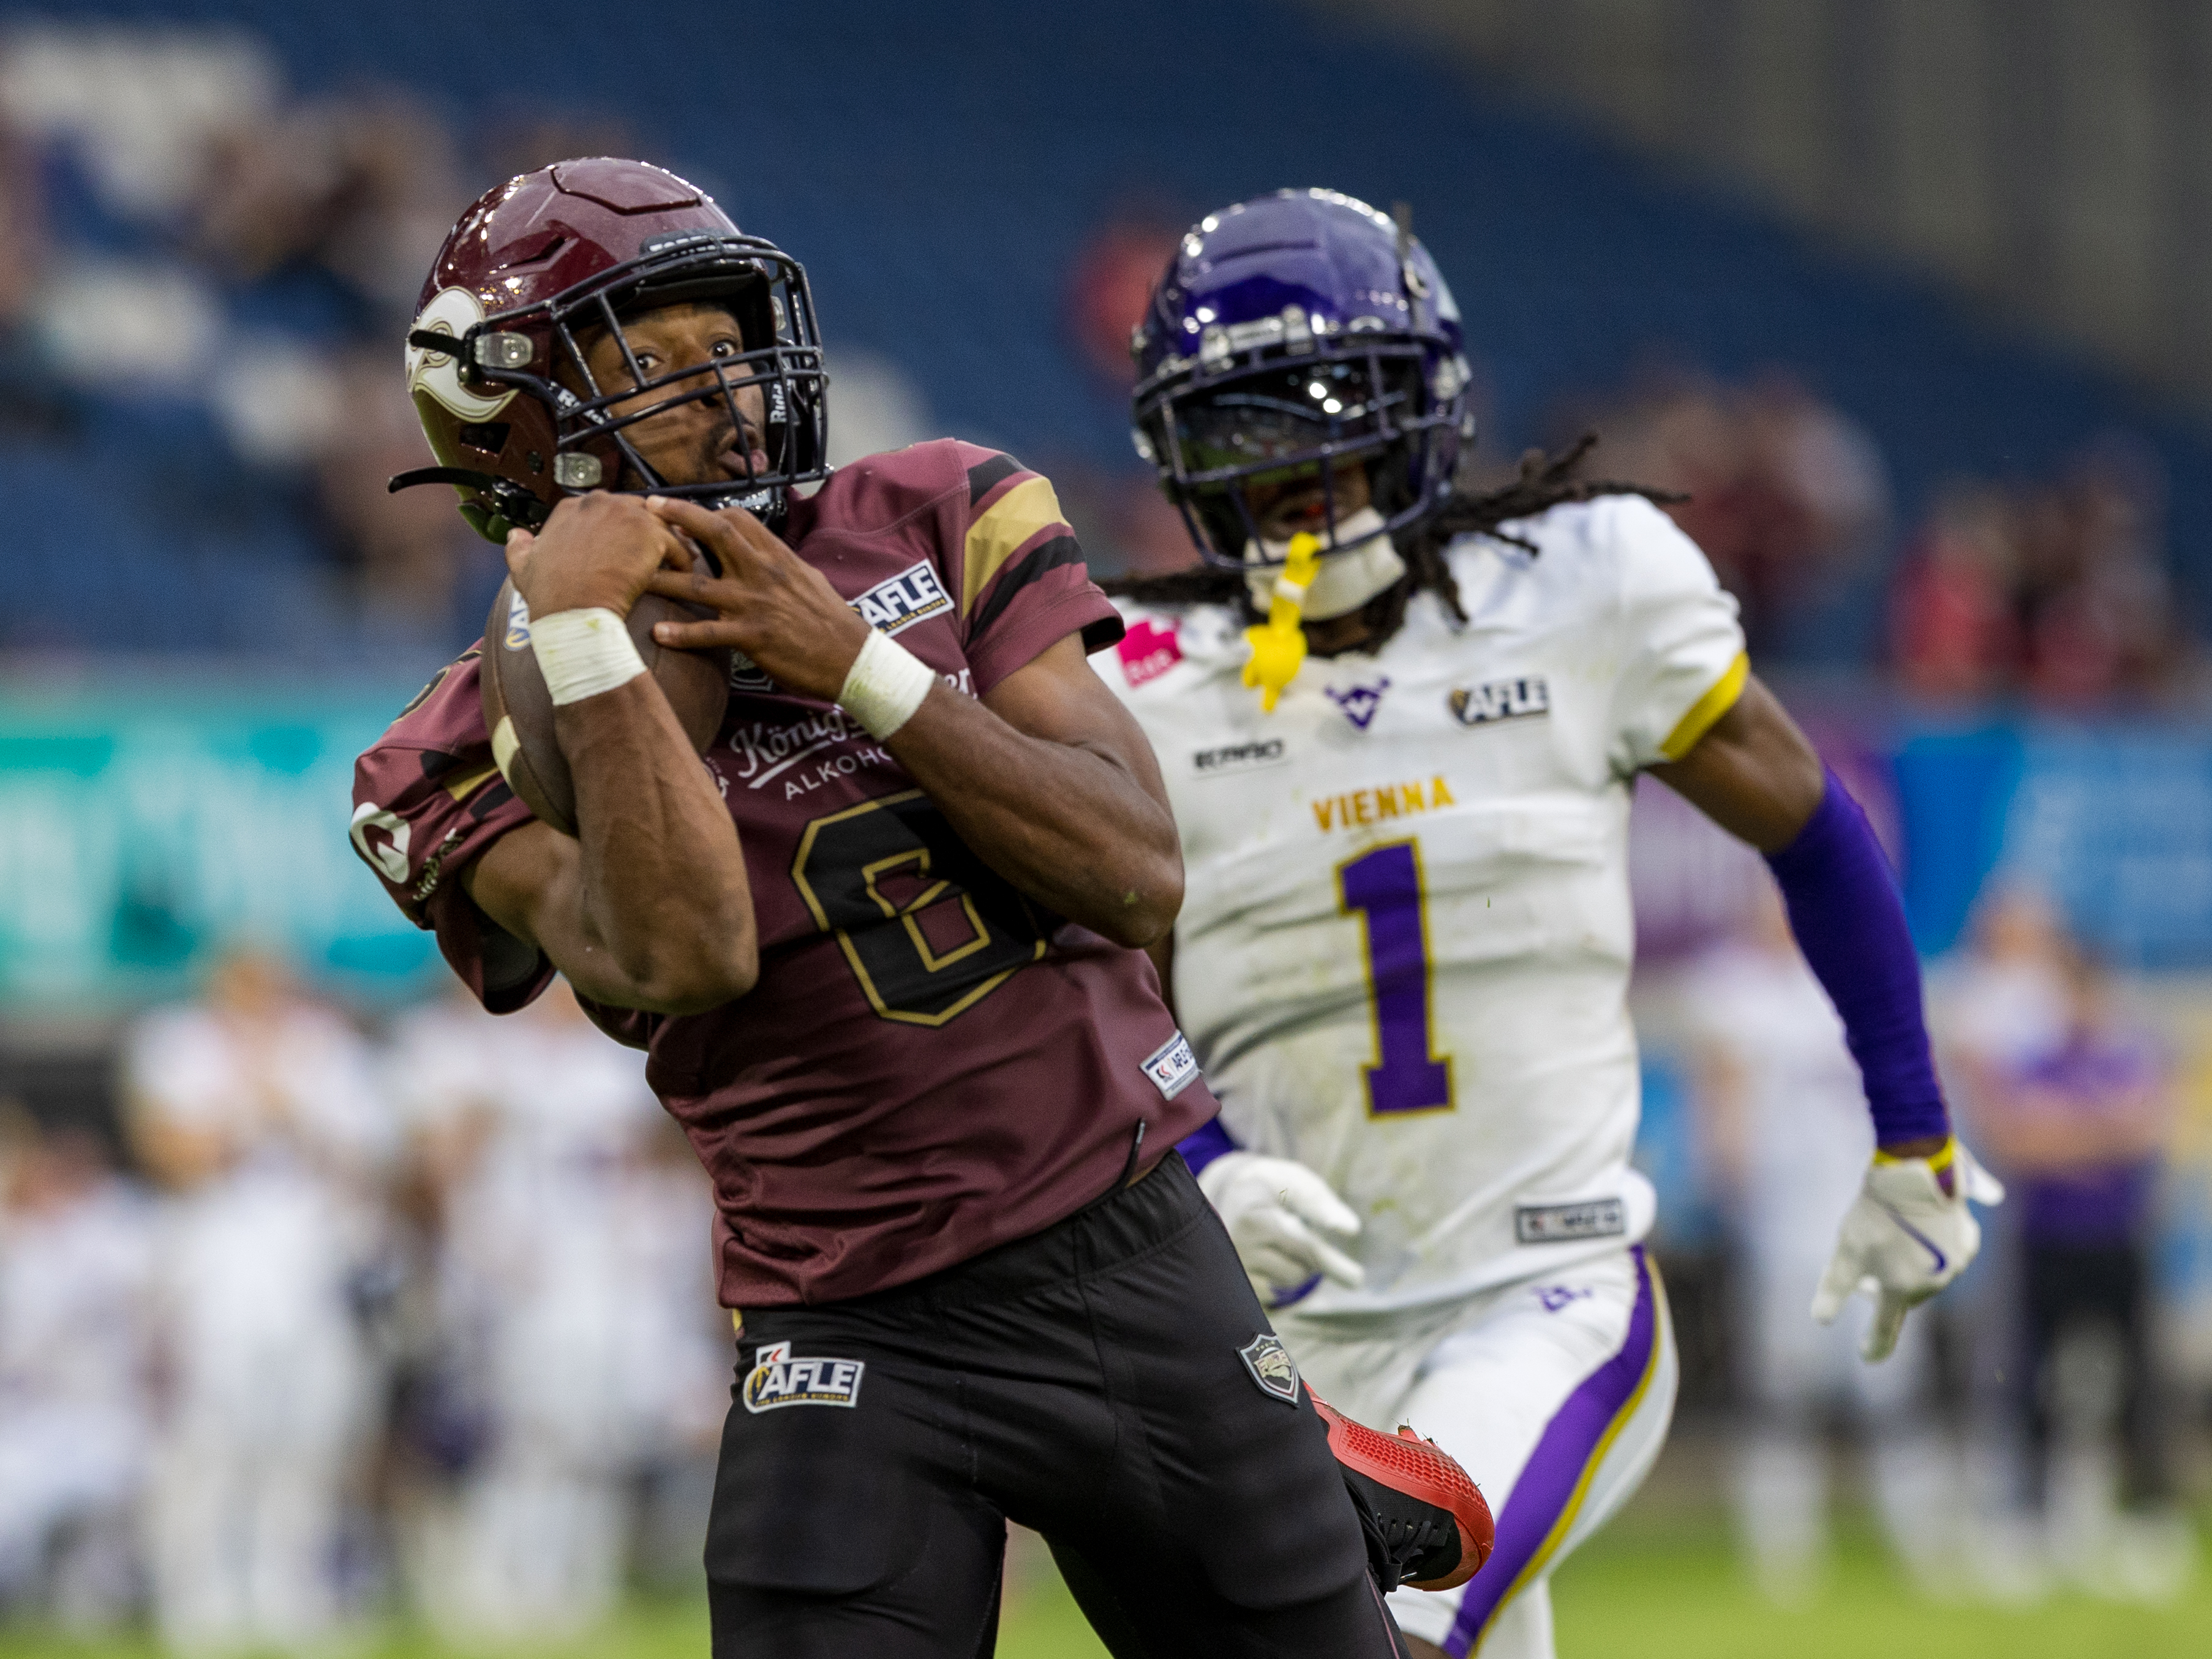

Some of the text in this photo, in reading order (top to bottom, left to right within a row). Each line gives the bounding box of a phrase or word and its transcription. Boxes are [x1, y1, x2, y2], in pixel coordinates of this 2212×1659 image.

[858, 567, 942, 625] AFLE
[1466, 679, 1548, 724] AFLE
[1312, 775, 1456, 833] VIENNA
[1333, 836, 1456, 1122] 1
[756, 1362, 856, 1400] AFLE
